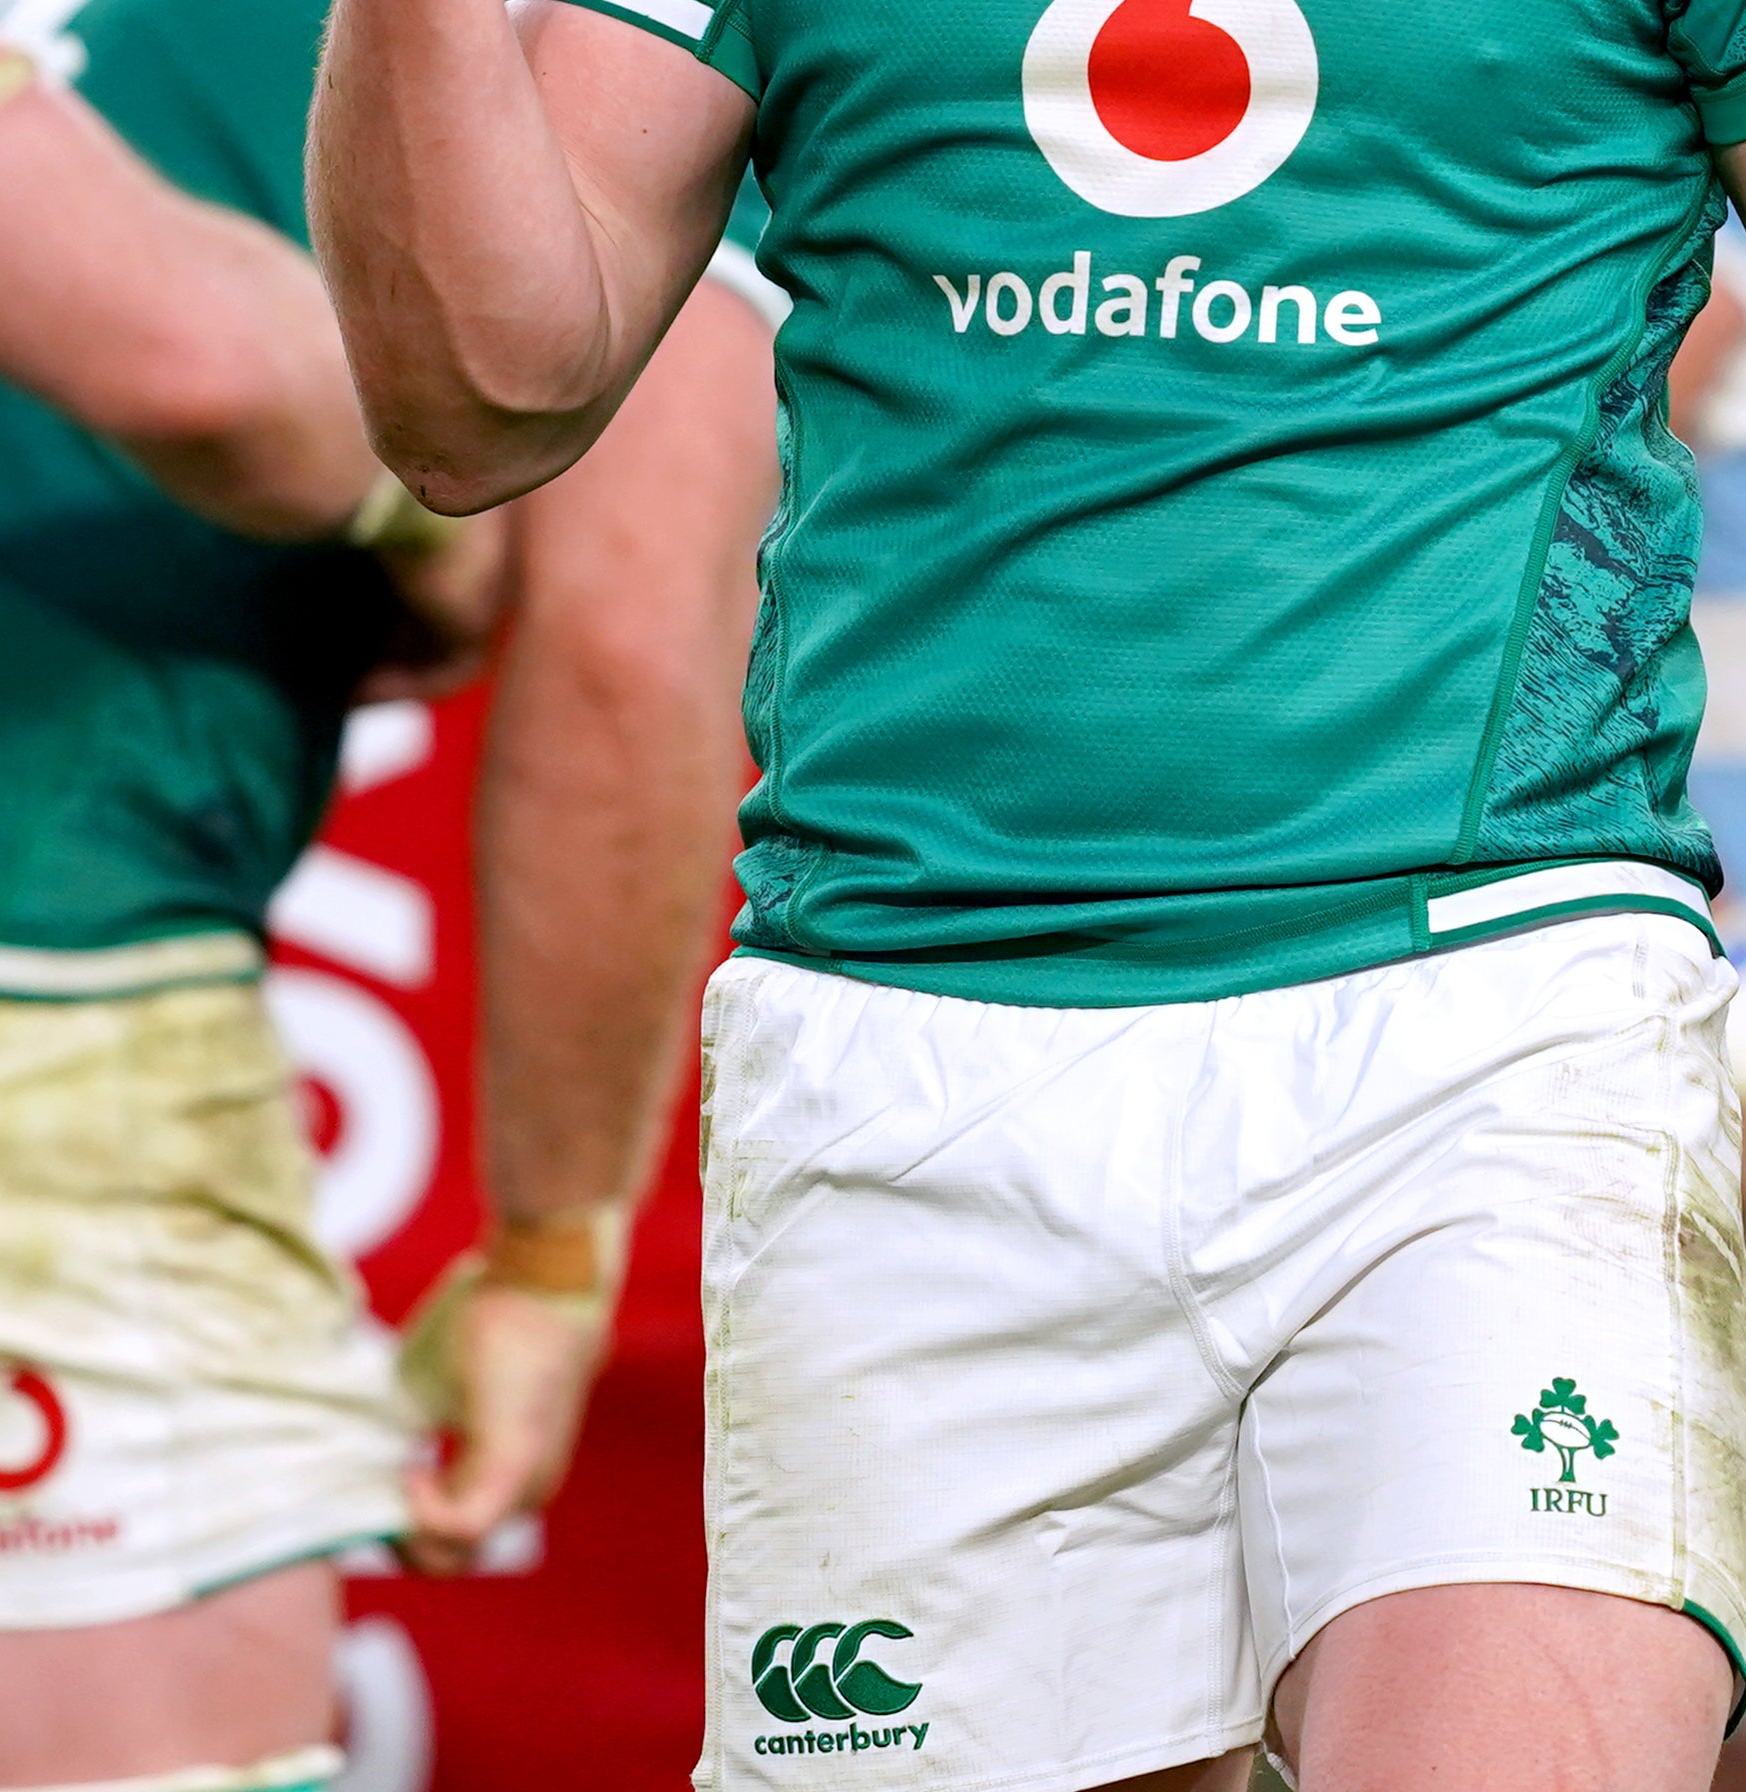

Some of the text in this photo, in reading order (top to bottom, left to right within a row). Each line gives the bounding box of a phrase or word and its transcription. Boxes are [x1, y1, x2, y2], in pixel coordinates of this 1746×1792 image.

[932, 250, 1382, 347] vodafone
[1529, 1487, 1608, 1517] IRFU
[754, 1722, 930, 1755] canterbury
